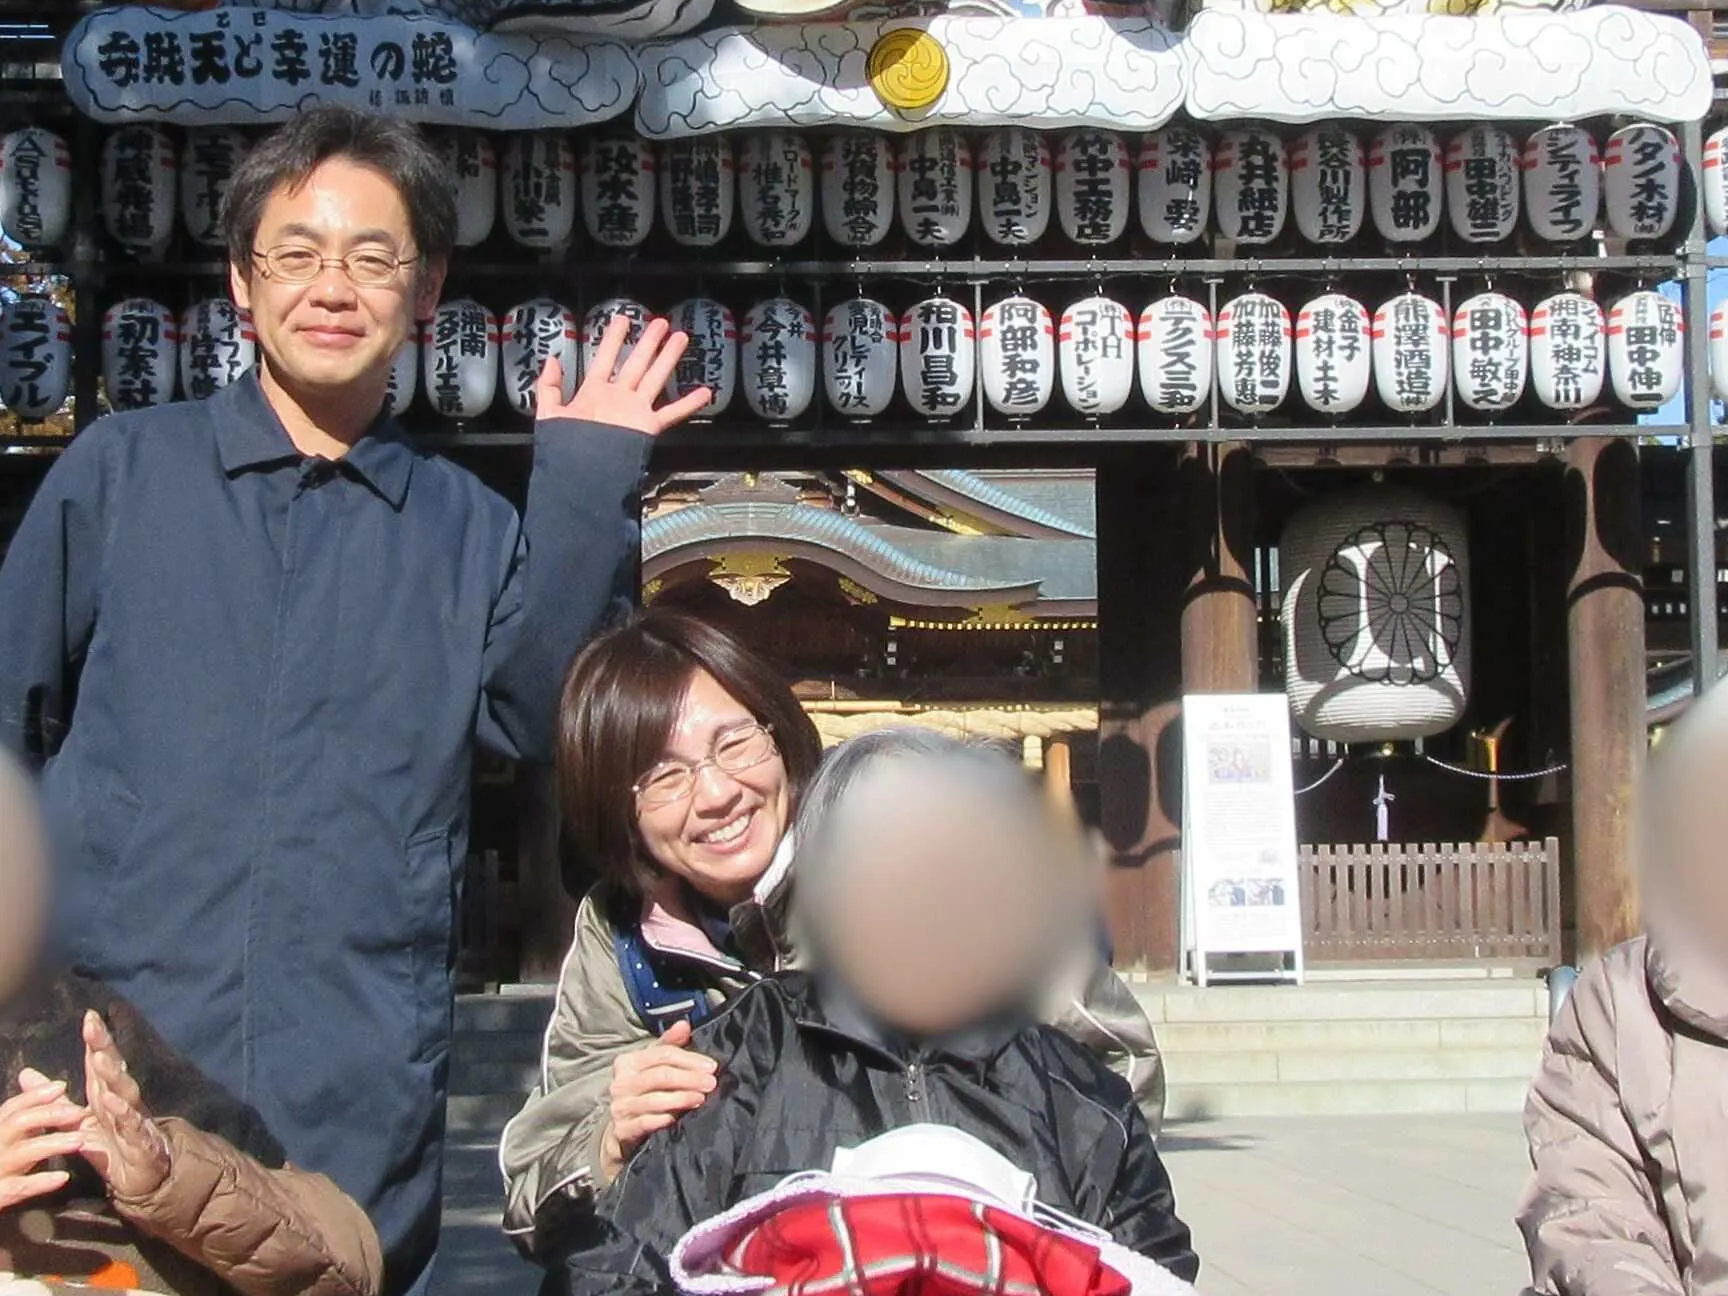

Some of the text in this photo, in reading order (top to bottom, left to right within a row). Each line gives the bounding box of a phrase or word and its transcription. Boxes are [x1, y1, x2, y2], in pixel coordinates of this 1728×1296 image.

[1071, 134, 1115, 240] 竹中工務店
[8, 310, 55, 408] エイブル
[459, 306, 487, 359] 湘南
[754, 315, 789, 416] 今井章博
[832, 335, 853, 409] クリニック
[999, 303, 1041, 406] 阿部和彦
[1074, 310, 1102, 410] コーポレーション
[1311, 307, 1341, 406] 建材土木
[1625, 326, 1665, 403] 田中伸一
